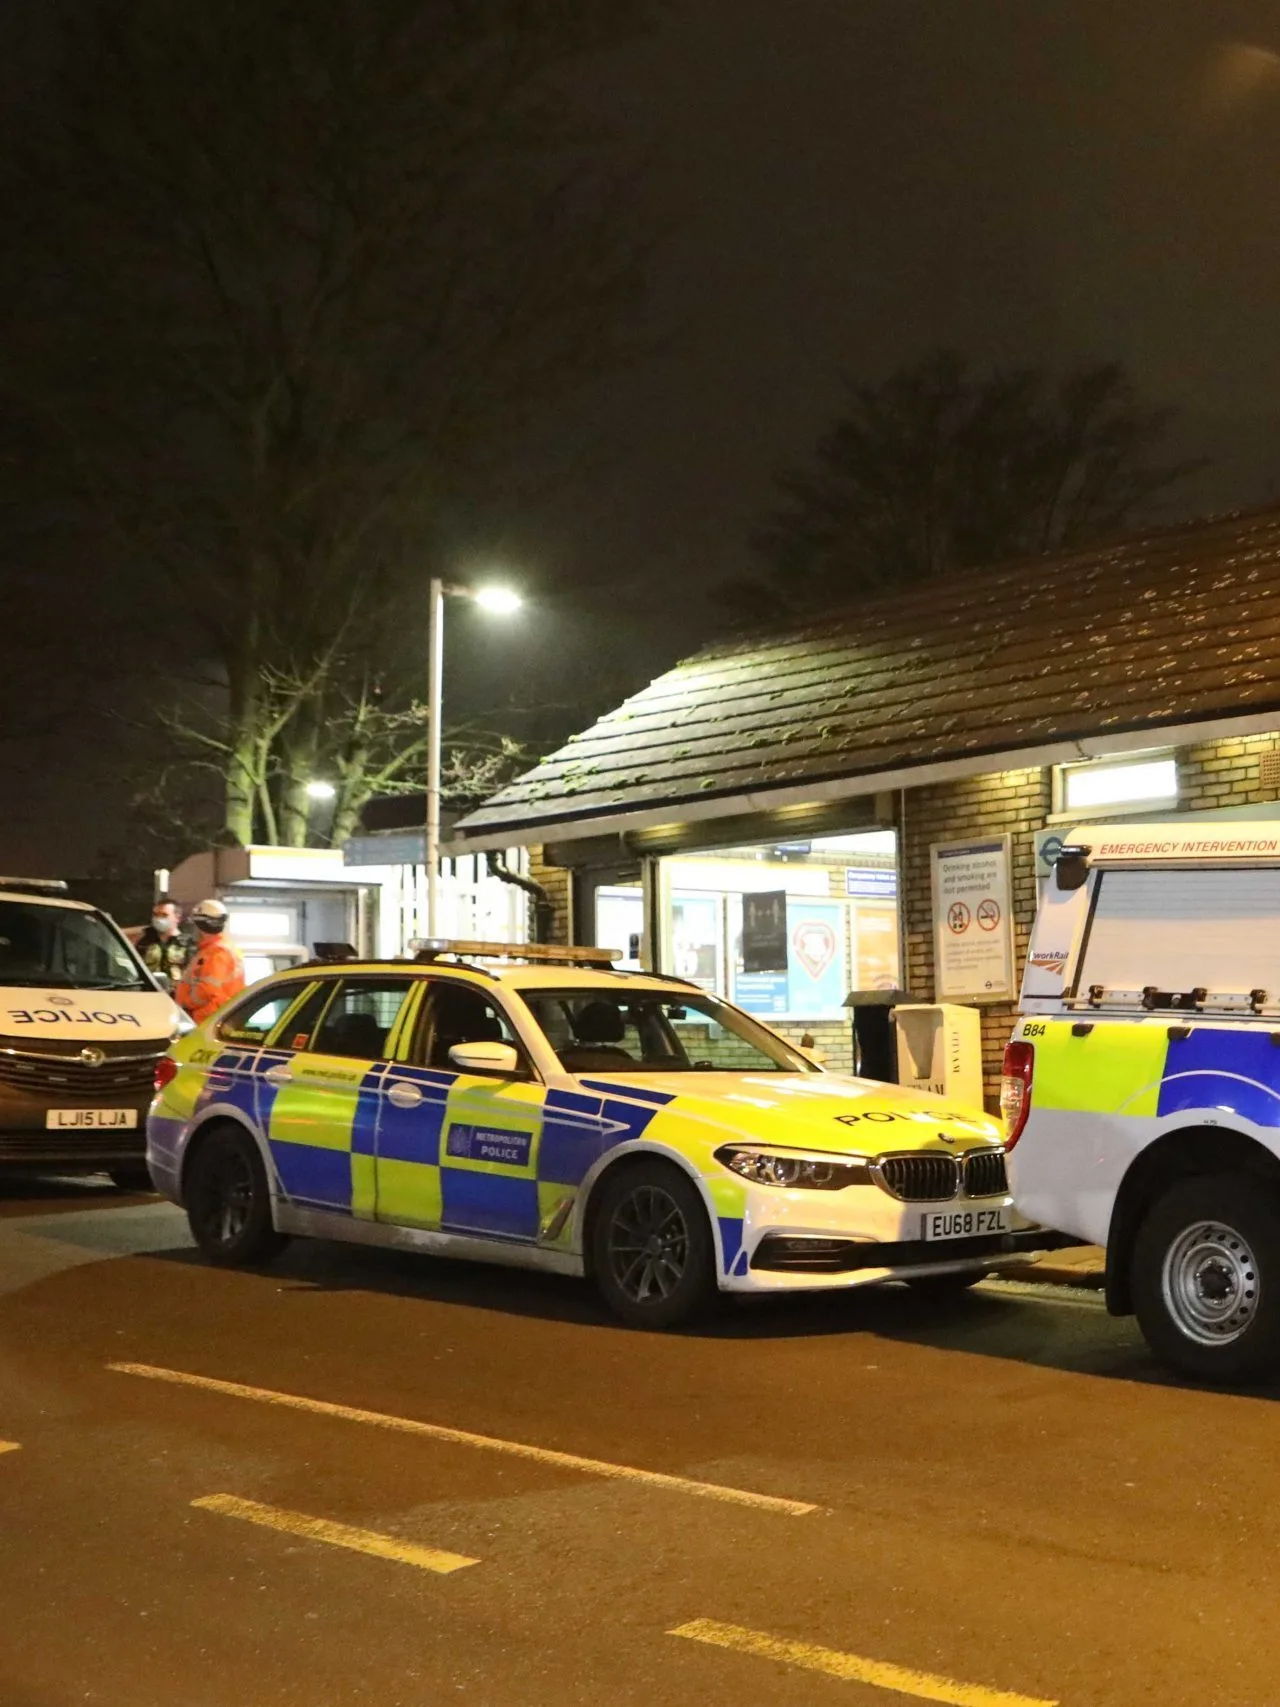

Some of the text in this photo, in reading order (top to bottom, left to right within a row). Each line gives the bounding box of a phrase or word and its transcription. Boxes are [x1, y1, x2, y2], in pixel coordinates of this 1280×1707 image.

[1100, 843, 1178, 855] EMERGENCY
[1181, 841, 1278, 853] INTERVENTION
[1023, 1023, 1046, 1037] B84
[98, 1112, 128, 1126] LJA
[480, 1145, 518, 1159] POLICE
[933, 1210, 1006, 1237] EU68 FZL
